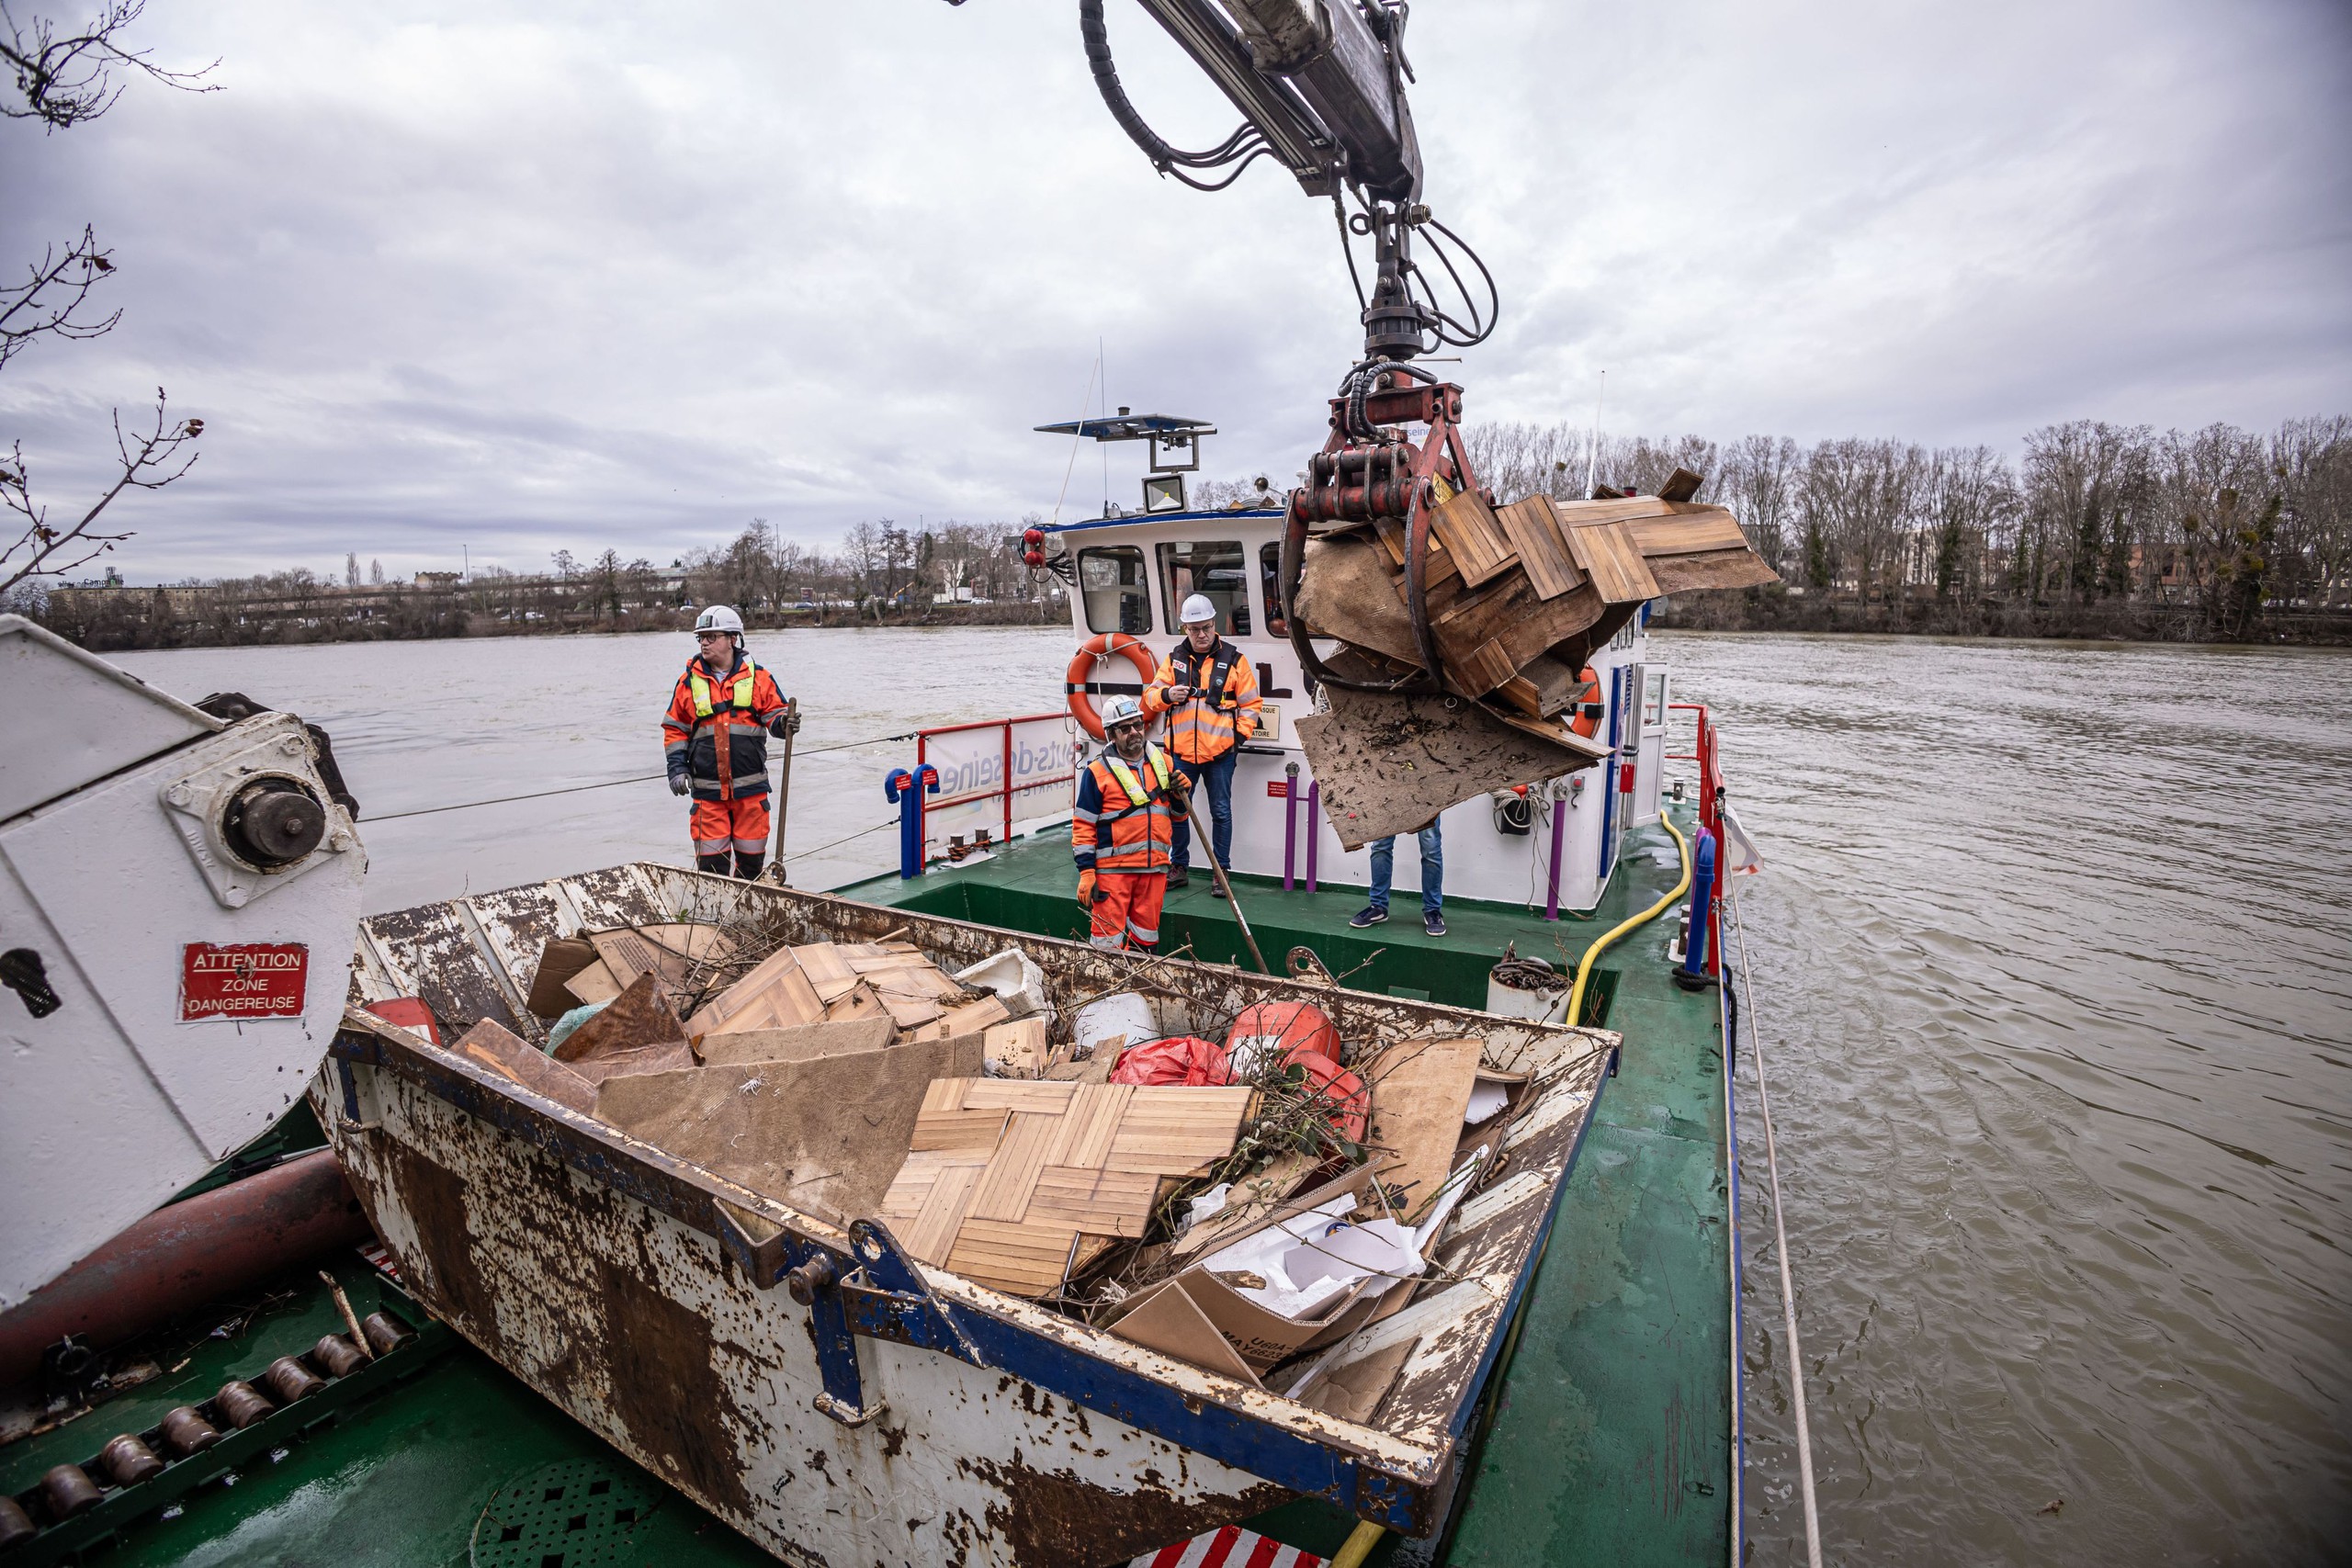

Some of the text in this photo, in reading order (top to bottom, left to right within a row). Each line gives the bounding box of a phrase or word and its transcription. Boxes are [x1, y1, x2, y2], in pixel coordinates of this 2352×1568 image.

[1408, 426, 1430, 436] sein
[193, 953, 301, 968] ATTENTION
[221, 979, 268, 992] ZONE
[188, 996, 296, 1012] DANGEREUSE
